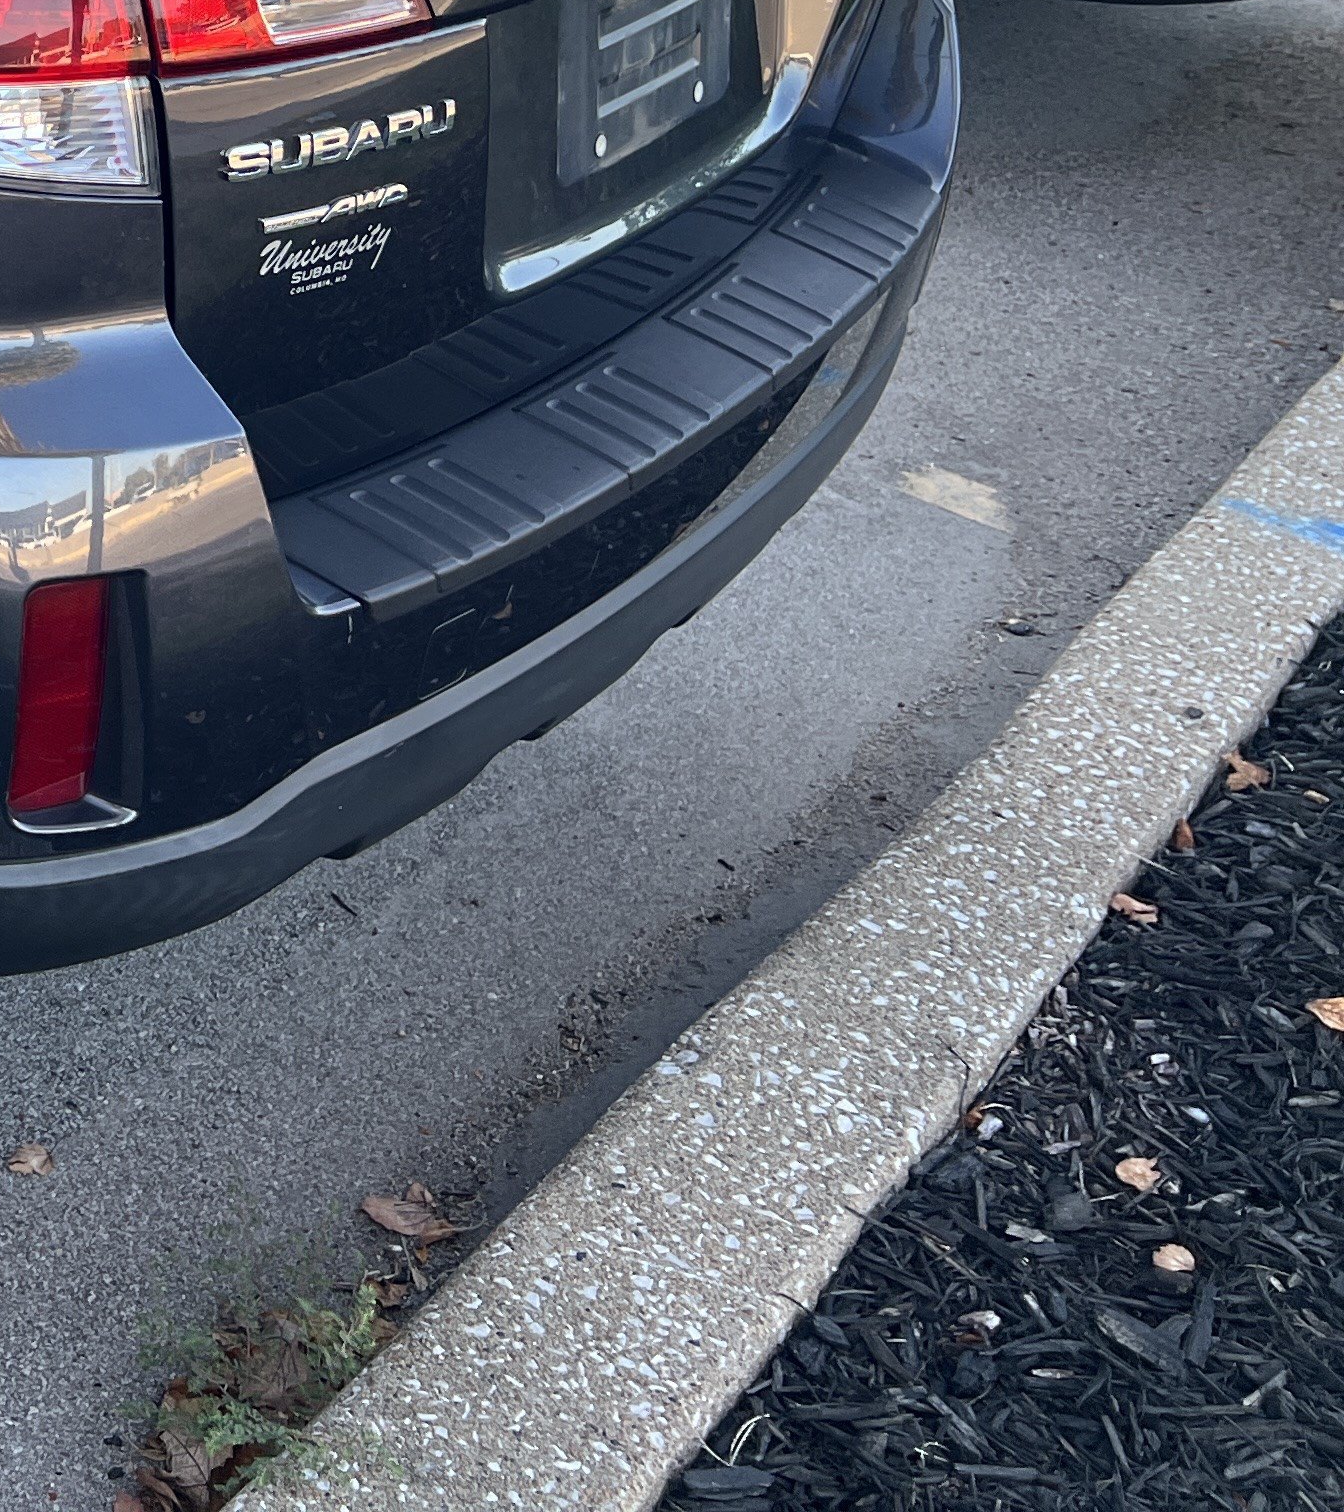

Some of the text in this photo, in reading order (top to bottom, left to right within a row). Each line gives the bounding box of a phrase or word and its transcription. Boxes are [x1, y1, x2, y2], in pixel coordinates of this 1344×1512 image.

[220, 98, 456, 183] SUBARU
[259, 223, 392, 277] University
[290, 258, 353, 285] SUBARU
